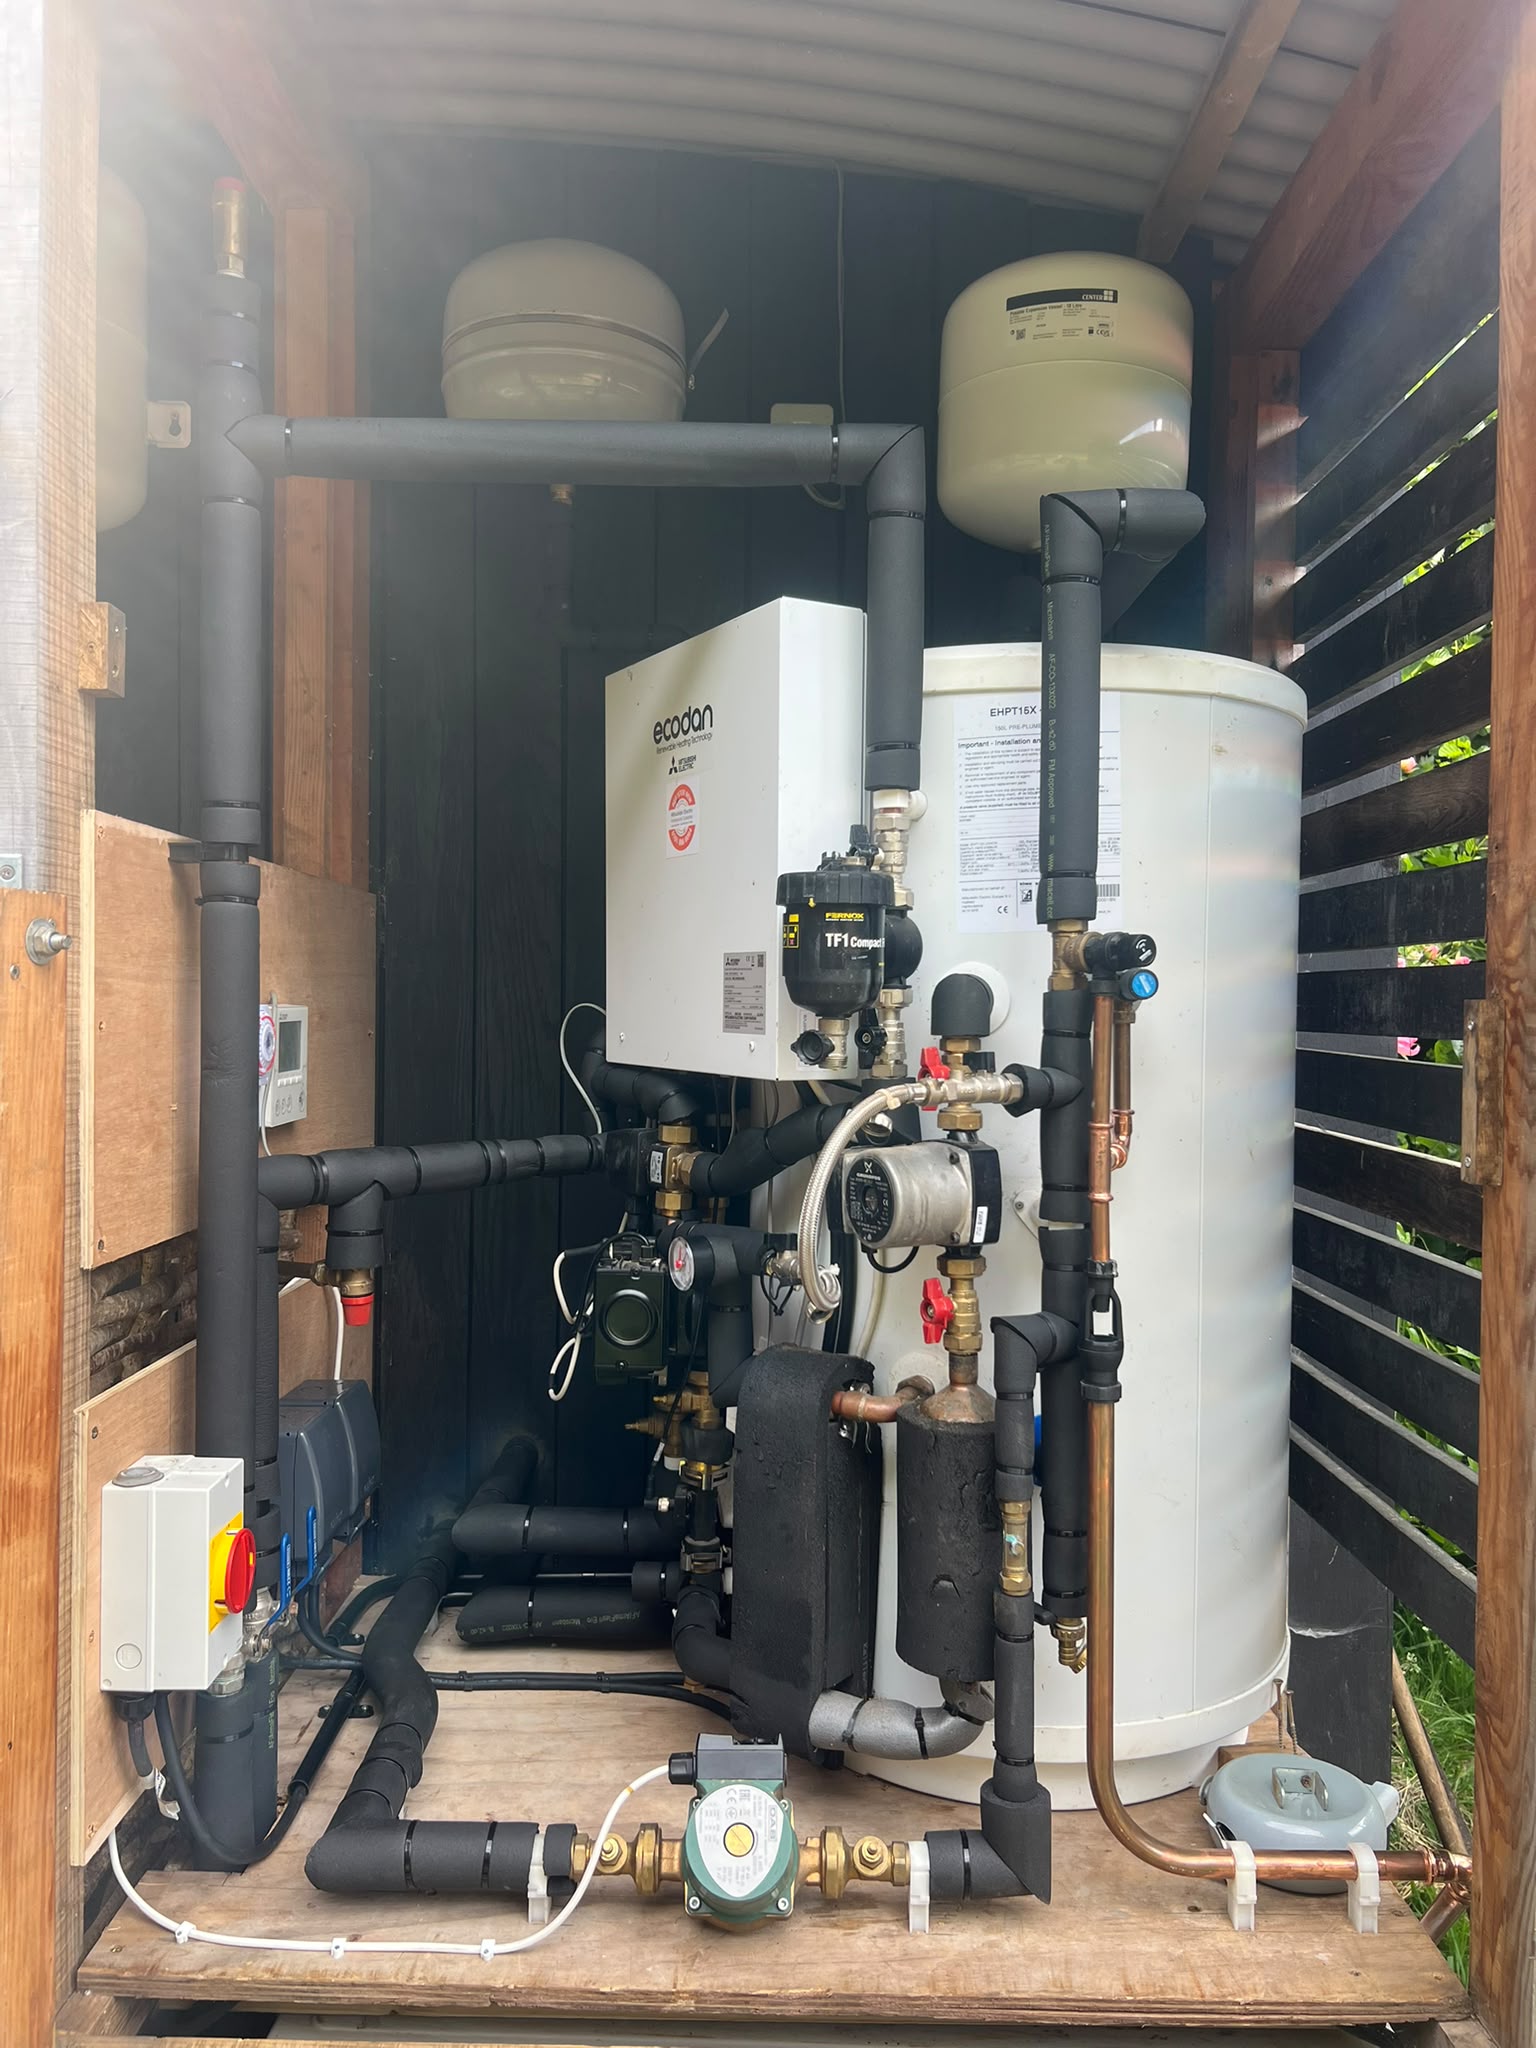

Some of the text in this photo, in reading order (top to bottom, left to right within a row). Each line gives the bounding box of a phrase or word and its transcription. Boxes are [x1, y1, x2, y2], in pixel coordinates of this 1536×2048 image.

[653, 704, 713, 745] ecodan
[957, 741, 989, 749] Important
[995, 738, 1031, 746] Installation
[1047, 773, 1056, 809] Approved
[825, 933, 849, 947] TF1
